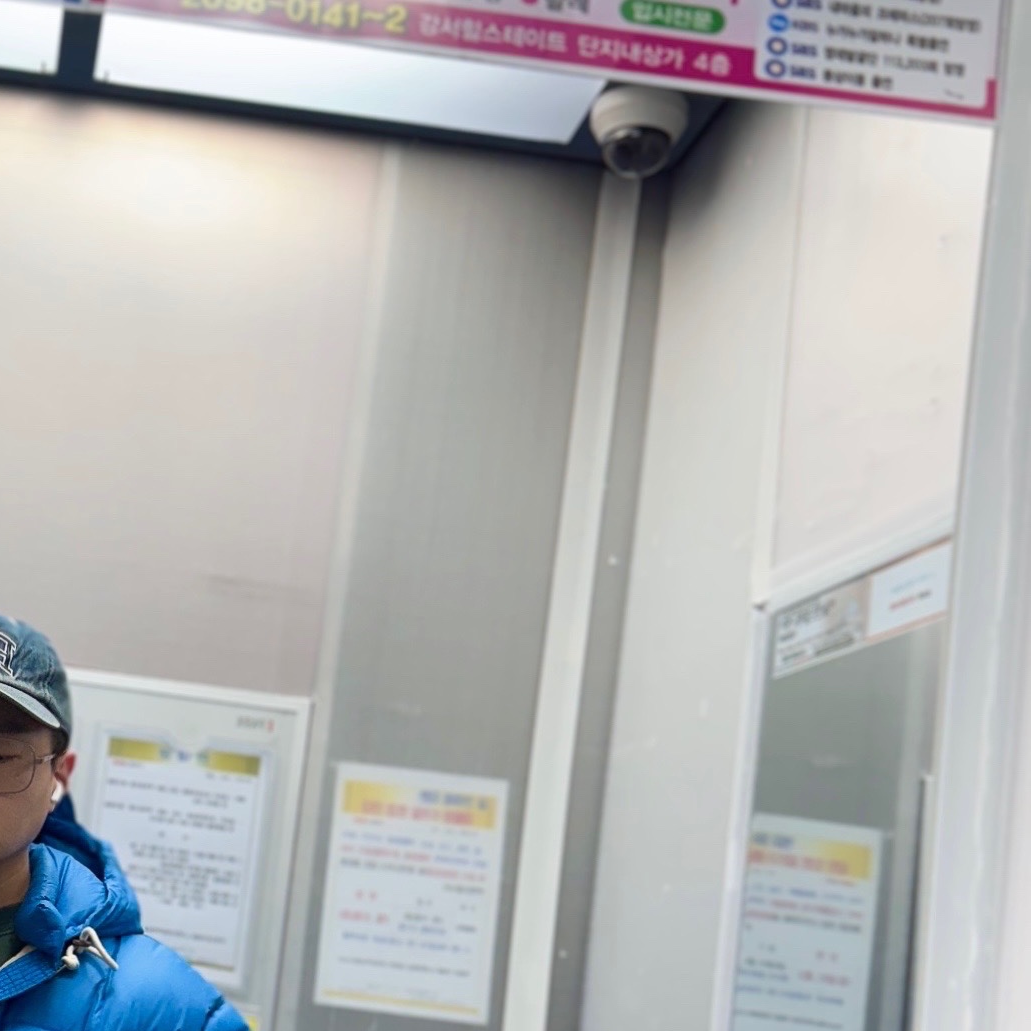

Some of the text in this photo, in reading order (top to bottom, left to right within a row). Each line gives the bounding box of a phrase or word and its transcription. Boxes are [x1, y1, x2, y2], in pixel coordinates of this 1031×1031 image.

[630, 4, 713, 32] 입시전문
[578, 34, 685, 70] 단지내상가
[694, 53, 732, 77] 4층
